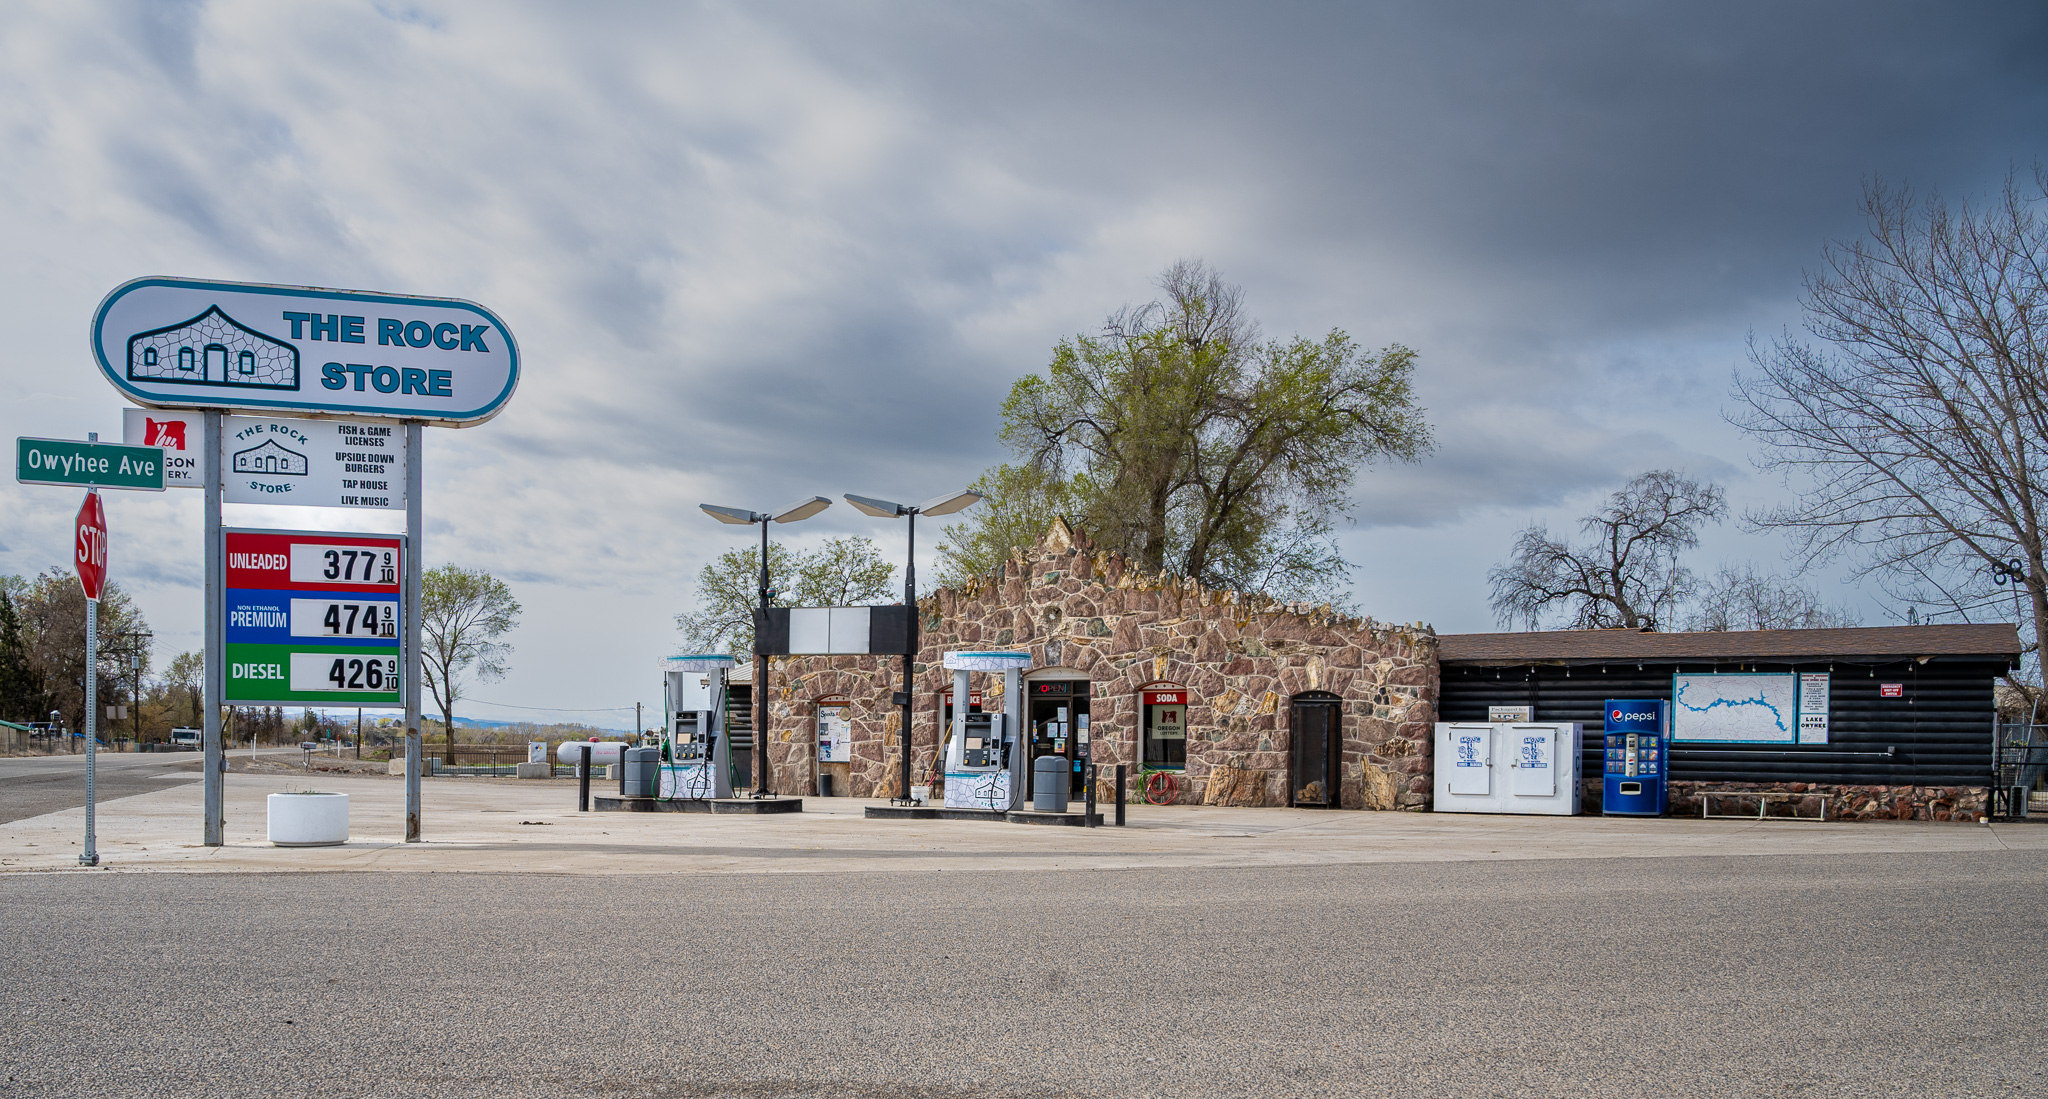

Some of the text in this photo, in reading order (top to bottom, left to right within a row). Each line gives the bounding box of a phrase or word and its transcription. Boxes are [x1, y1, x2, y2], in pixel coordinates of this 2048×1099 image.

[283, 311, 490, 353] THE ROCK
[321, 362, 452, 397] STORE
[236, 424, 308, 445] THE ROCK
[338, 425, 392, 437] FISH & GAME
[345, 437, 385, 447] LICENSES
[28, 449, 155, 477] Owyhee Ave
[166, 457, 195, 468] GON
[335, 452, 395, 464] UPSIDE DOWN
[345, 464, 385, 474] BURGERS
[250, 481, 292, 494] STORE
[342, 479, 388, 491] TAP HOUSE
[341, 496, 389, 507] LIVE MUSIC
[78, 524, 106, 568] STOP
[229, 550, 394, 582] UNLEADED 377 9 10
[230, 604, 394, 636] PREMIUM 474 9 10
[232, 658, 398, 690] DIESEL 426 9 10
[1041, 684, 1065, 693] OPEN
[969, 696, 981, 704] ICE
[1156, 693, 1178, 703] SODA
[1625, 711, 1656, 722] pepsi
[976, 775, 986, 784] THE
